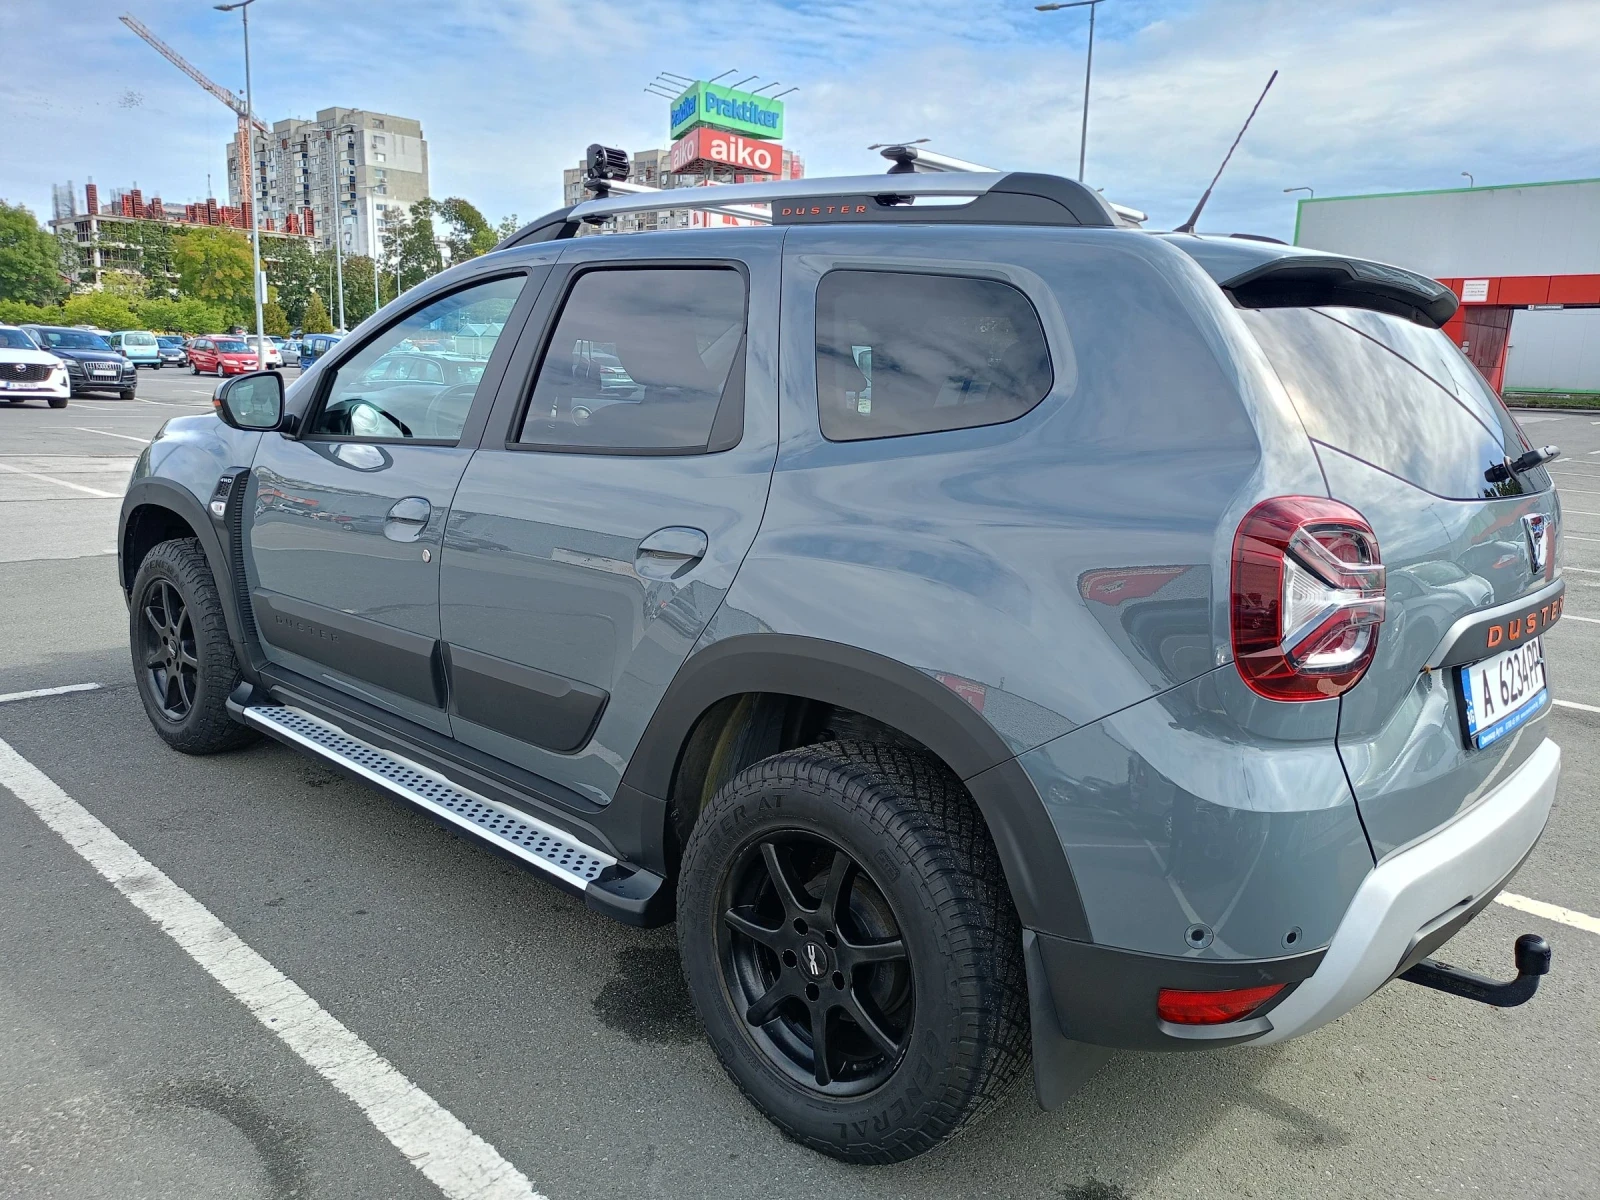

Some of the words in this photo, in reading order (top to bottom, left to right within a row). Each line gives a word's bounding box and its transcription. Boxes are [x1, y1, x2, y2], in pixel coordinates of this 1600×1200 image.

[671, 94, 697, 130] Praktiker
[705, 92, 780, 129] Praktiker
[673, 136, 695, 168] aiko
[710, 135, 772, 170] aiko
[781, 204, 868, 216] DUSTER
[275, 614, 341, 644] DUSTER
[1487, 597, 1562, 648] DUSTER
[1482, 668, 1495, 719] A
